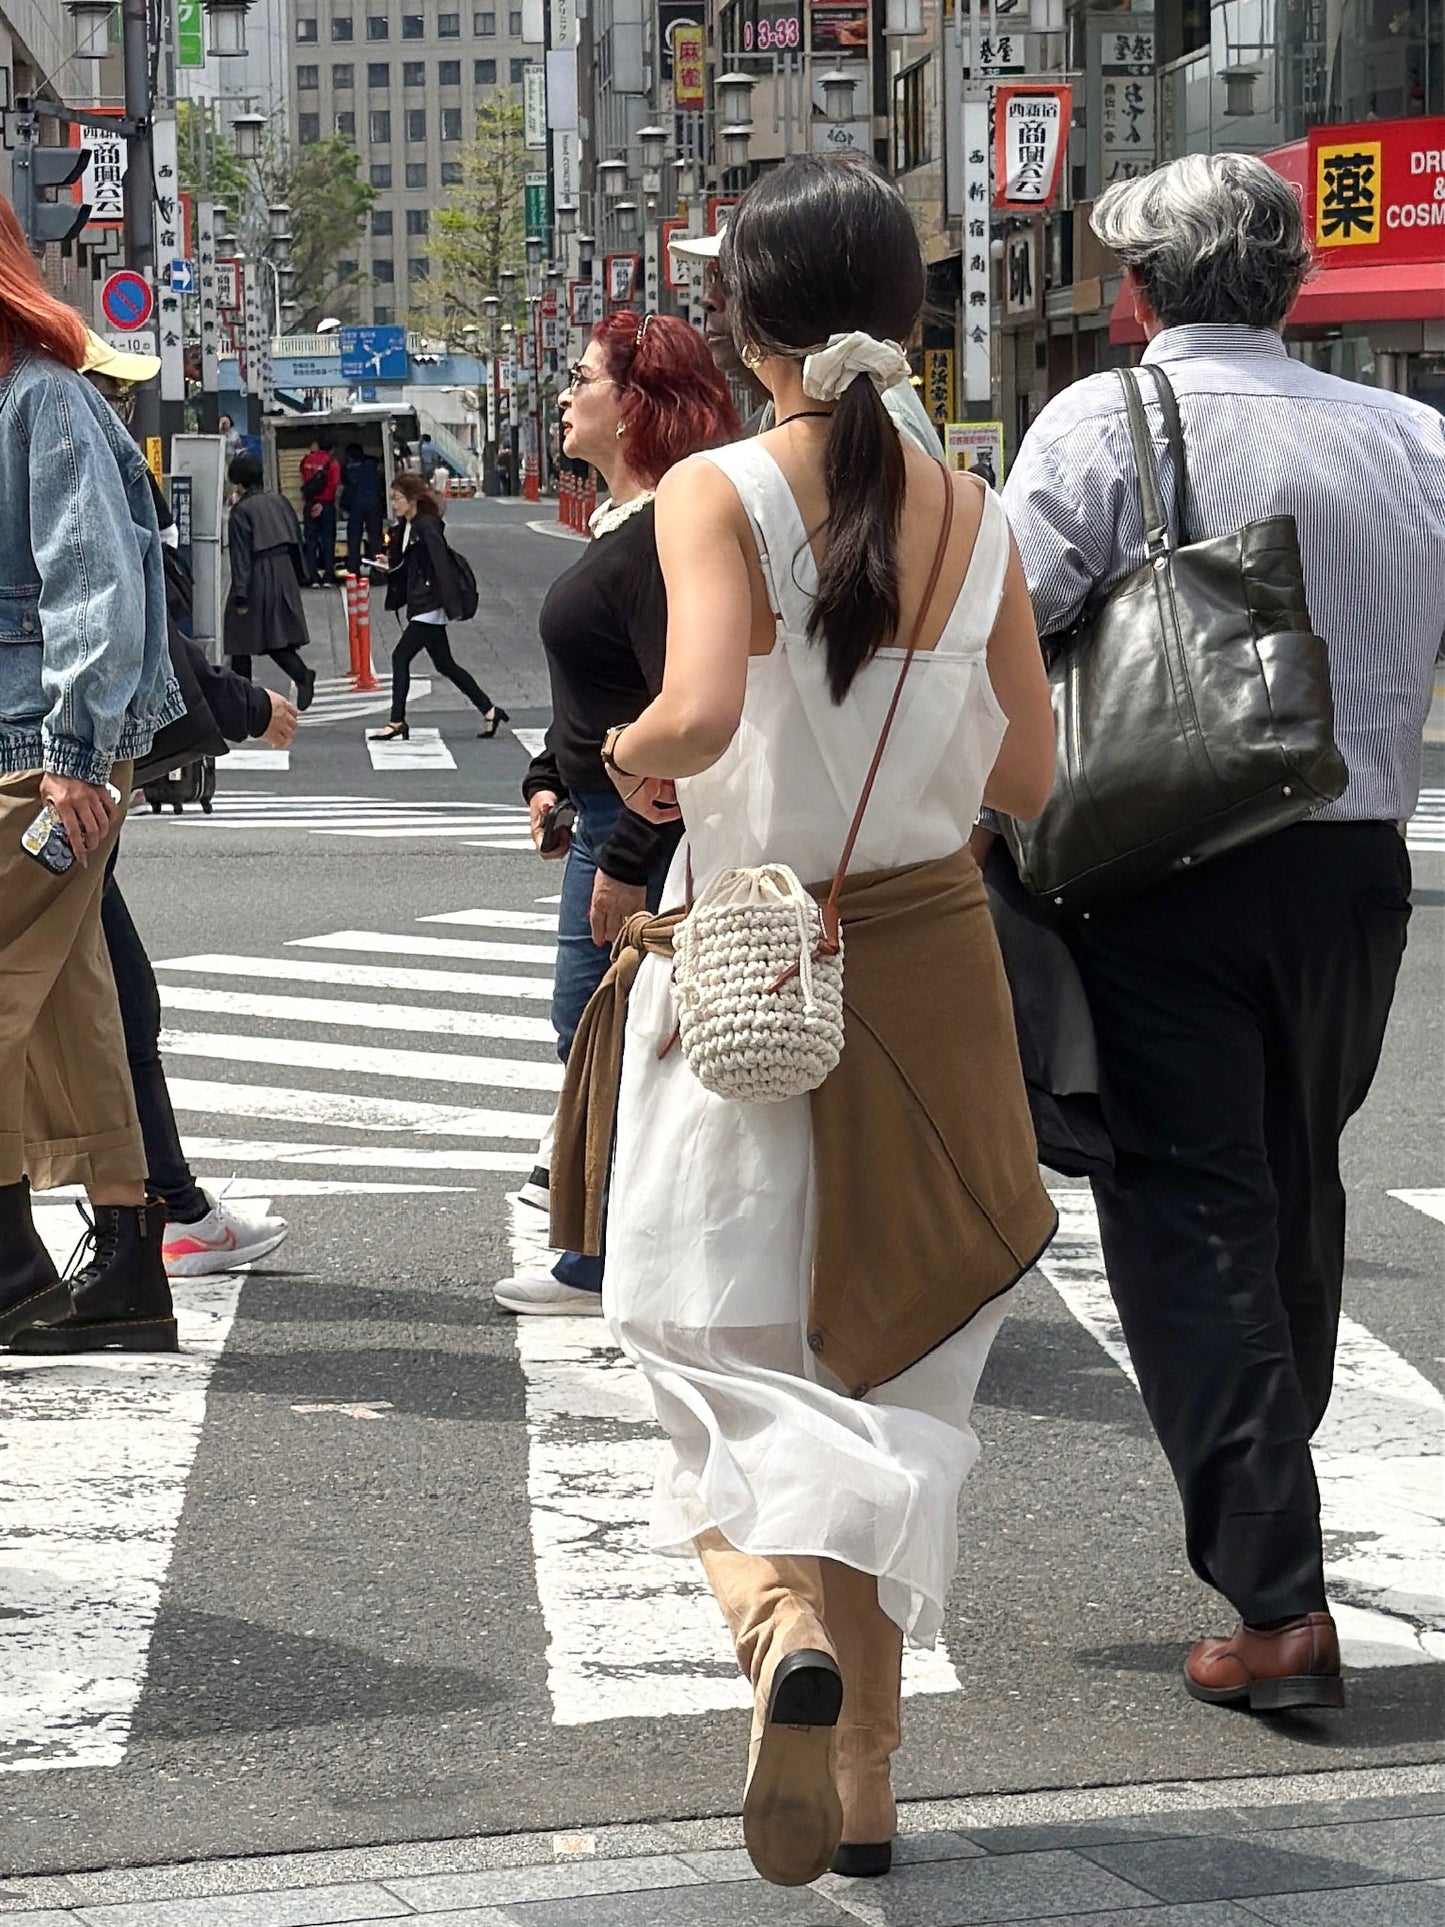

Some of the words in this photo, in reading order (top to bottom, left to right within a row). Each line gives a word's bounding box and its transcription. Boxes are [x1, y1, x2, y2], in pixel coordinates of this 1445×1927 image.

[680, 41, 699, 88] 麻雀
[1009, 103, 1058, 118] 西新宿
[1321, 152, 1375, 238] 薬
[1433, 176, 1445, 200] &
[1386, 202, 1445, 228] COSM
[968, 150, 988, 344] 西新宿商興会
